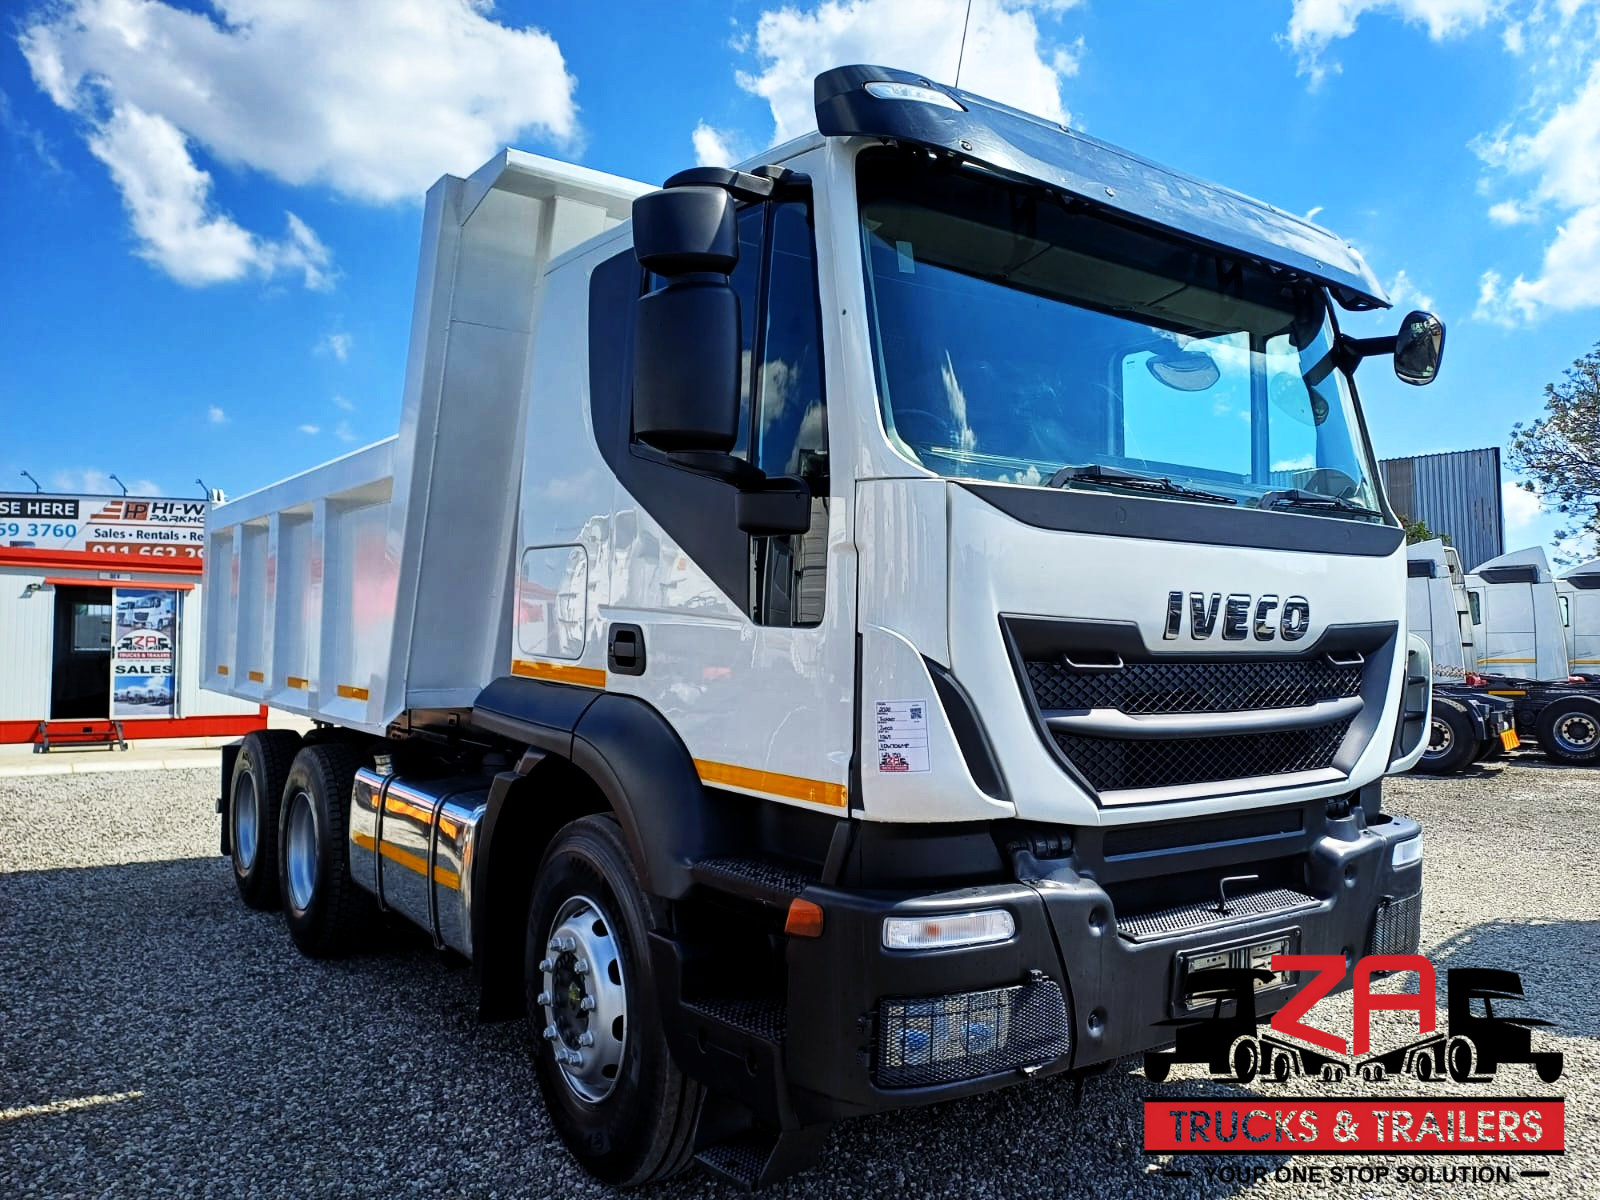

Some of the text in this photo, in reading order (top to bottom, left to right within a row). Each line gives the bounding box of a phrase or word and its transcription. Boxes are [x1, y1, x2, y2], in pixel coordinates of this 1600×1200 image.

[0, 502, 75, 516] SE HERE
[151, 502, 205, 515] HI-W
[27, 524, 76, 538] 3760
[94, 528, 126, 539] Sales
[136, 529, 180, 541] Rentals
[1163, 591, 1310, 641] IVECO
[134, 635, 157, 648] ZA
[115, 665, 173, 674] SALES
